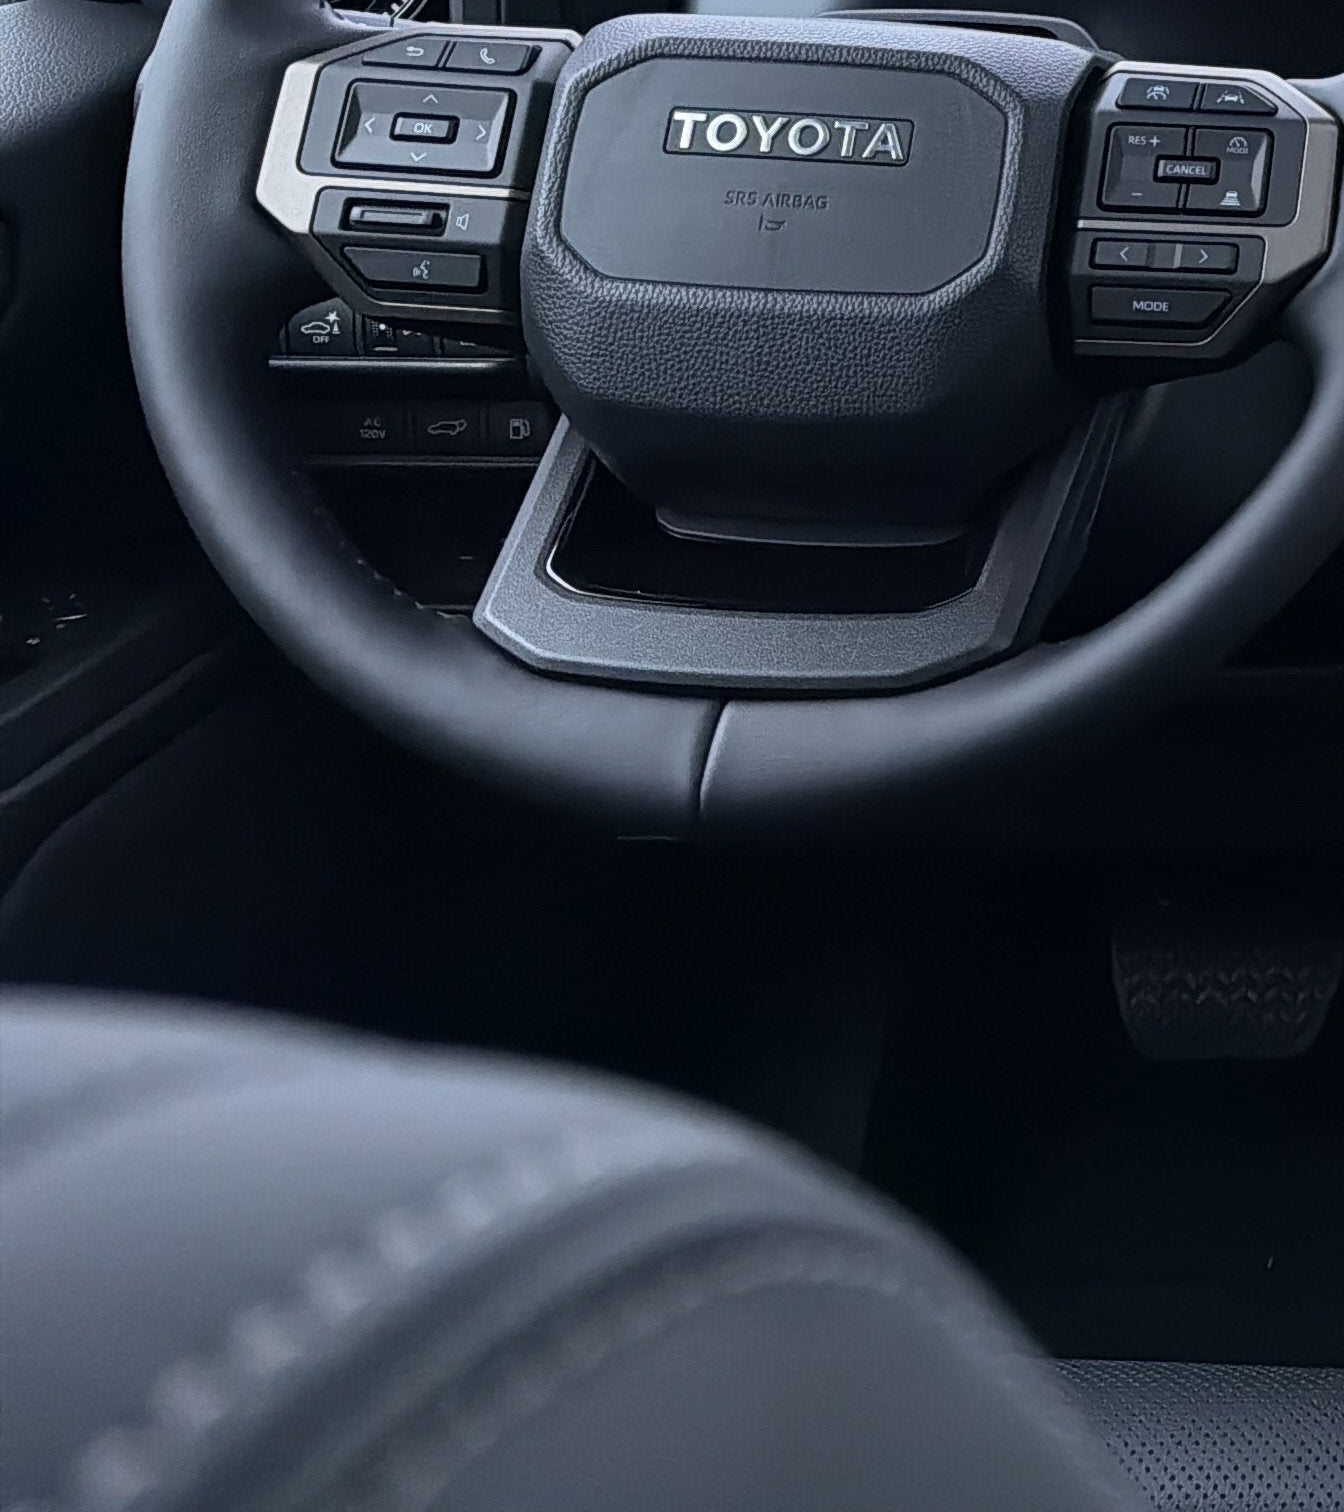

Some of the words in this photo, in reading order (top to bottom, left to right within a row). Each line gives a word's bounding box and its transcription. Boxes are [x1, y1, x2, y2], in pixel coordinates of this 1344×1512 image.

[411, 120, 433, 135] OK
[672, 110, 904, 160] TOYOTA
[1127, 134, 1147, 146] RES
[1165, 163, 1207, 176] CANCEL
[723, 189, 758, 207] SRS
[761, 191, 829, 210] AIRBAG
[1132, 299, 1169, 313] MODE
[313, 335, 330, 344] OFF
